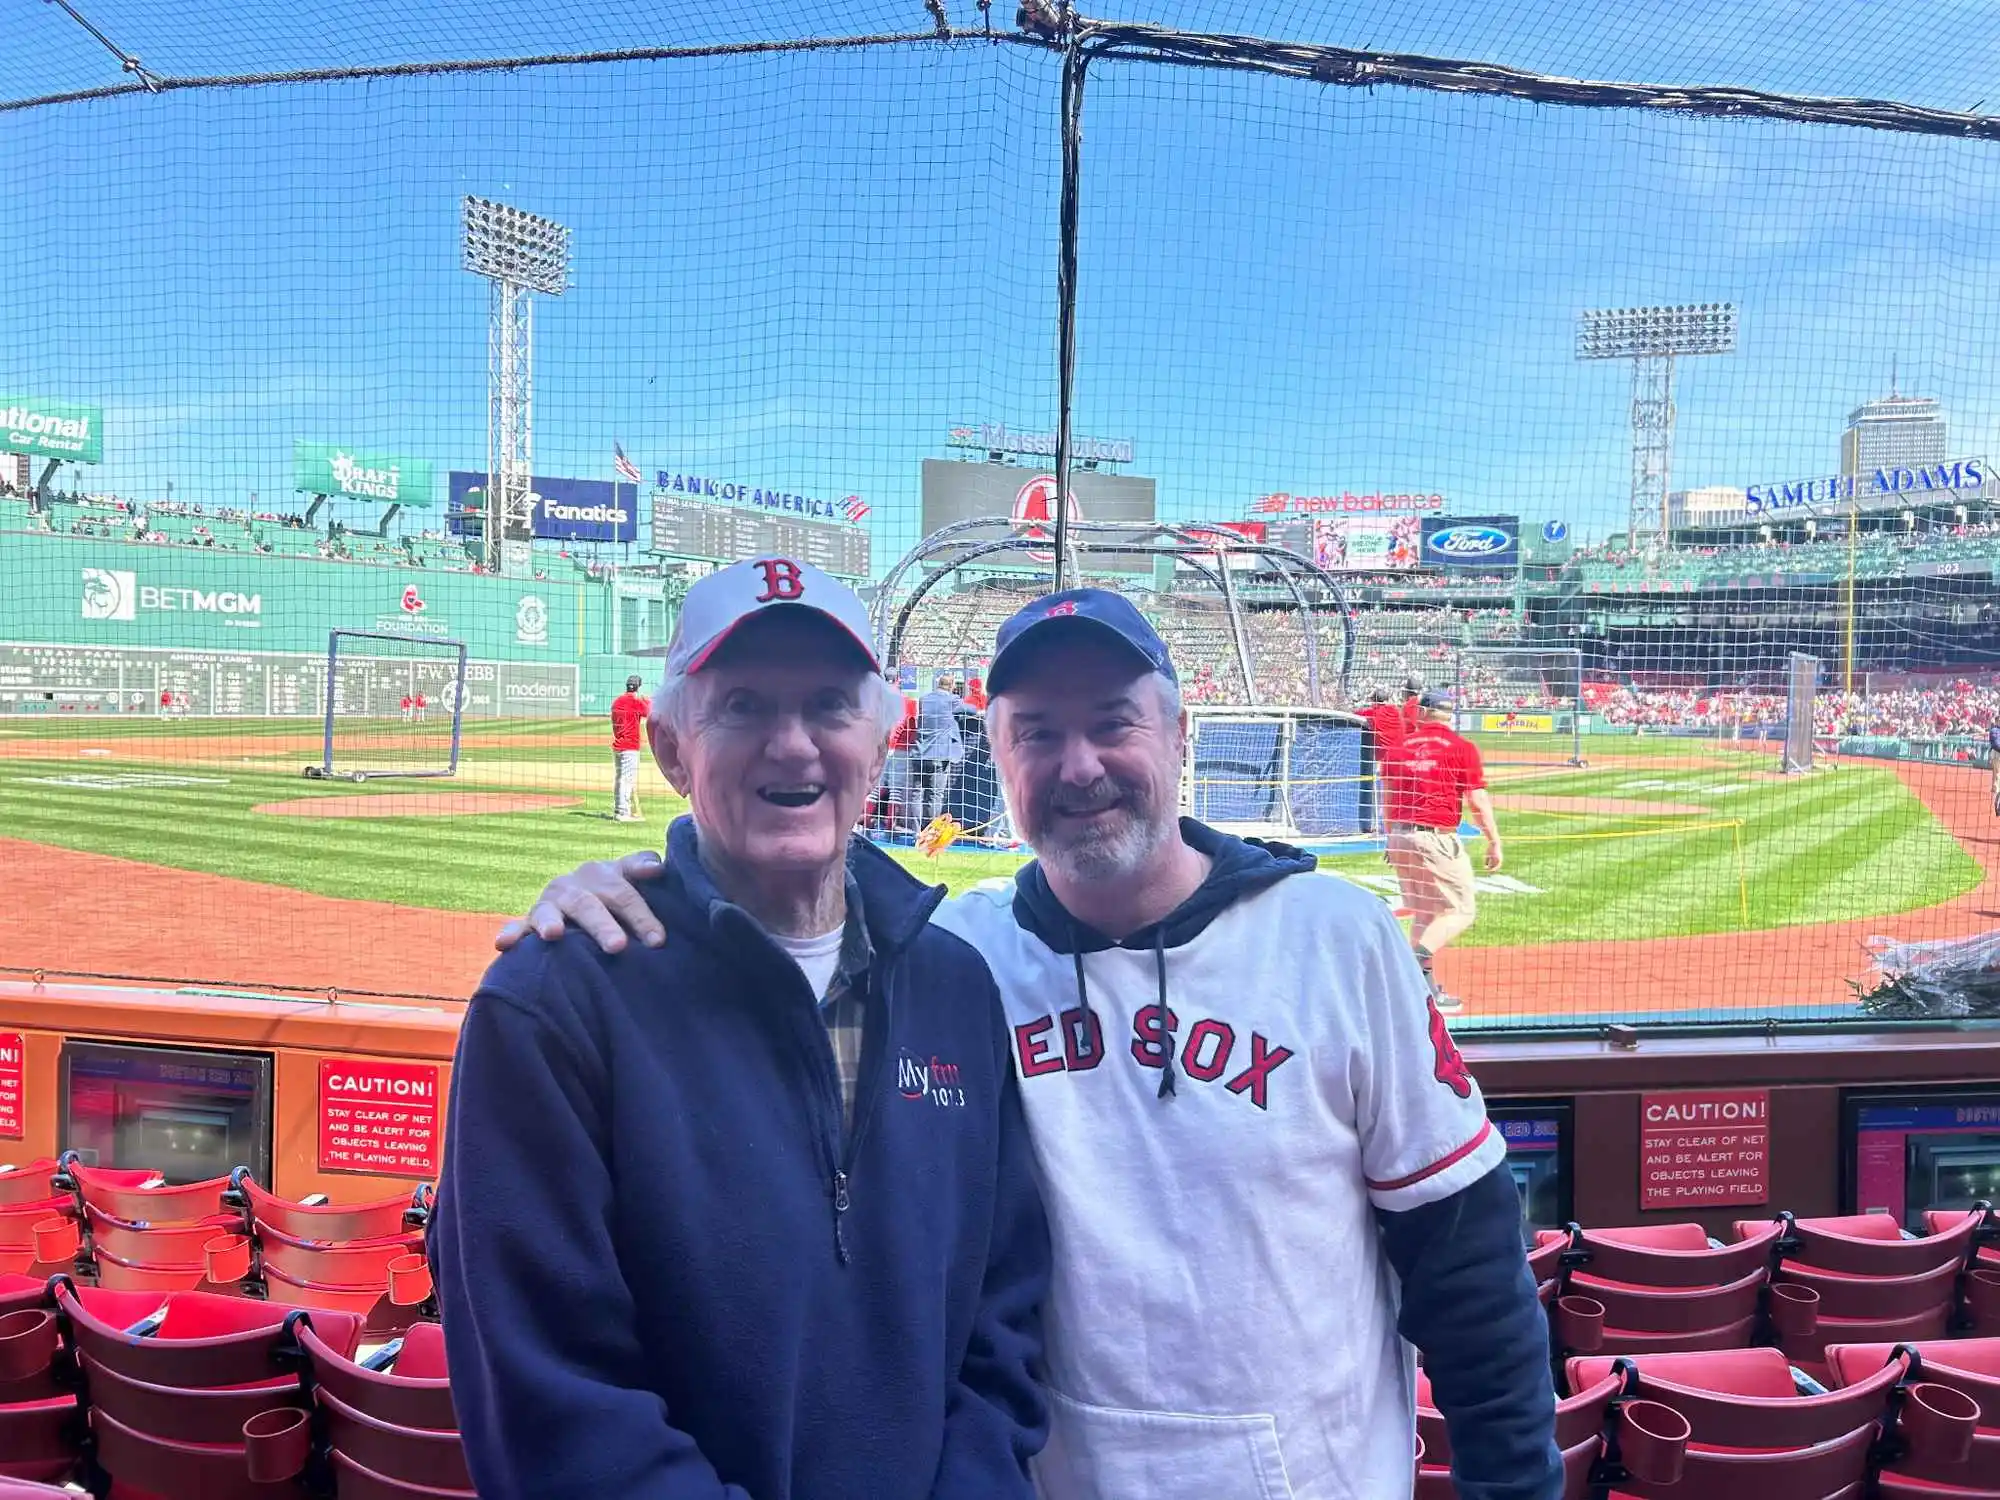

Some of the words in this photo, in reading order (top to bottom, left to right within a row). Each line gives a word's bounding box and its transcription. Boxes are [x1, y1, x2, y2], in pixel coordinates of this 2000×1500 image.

[37, 435, 84, 451] Rental
[334, 464, 399, 485] DRAFT
[1871, 459, 1983, 493] ADAMS
[341, 480, 398, 499] KINGS
[656, 470, 718, 496] BANK
[722, 483, 747, 502] OF
[754, 488, 834, 518] AMERICA
[1294, 494, 1339, 512] new
[1343, 490, 1442, 512] balance
[544, 500, 628, 522] Fanatics
[1443, 533, 1494, 551] Ford
[753, 559, 804, 603] B
[140, 586, 261, 614] BETMGM
[376, 620, 448, 634] FOUNDATION
[12, 648, 73, 656] FENWAY
[170, 654, 217, 662] AMERICAN
[505, 682, 570, 696] moderna
[1130, 1003, 1294, 1111] SOX
[899, 1057, 928, 1095] My
[328, 1075, 432, 1097] CAUTION!
[932, 1087, 966, 1107] 101.3
[328, 1108, 350, 1117] STAY
[355, 1110, 389, 1120] CLEAR
[393, 1113, 408, 1122] OF
[412, 1115, 432, 1124] NET
[1646, 1102, 1765, 1121] CAUTION!
[329, 1123, 349, 1132] AND
[354, 1125, 368, 1134] BE
[372, 1126, 405, 1136] ALERT
[409, 1129, 431, 1138] FOR
[332, 1137, 379, 1148] OBJECTS
[384, 1141, 427, 1152] LEAVING
[1645, 1138, 1672, 1148] STAY
[1677, 1137, 1716, 1147] CLEAR
[1722, 1136, 1738, 1145] OF
[1743, 1135, 1765, 1145] NET
[329, 1151, 349, 1160] THE
[354, 1152, 396, 1164] PLAYING
[401, 1156, 430, 1167] FIELD
[1647, 1155, 1670, 1165] AND
[1675, 1154, 1692, 1164] BE
[1697, 1152, 1734, 1162] ALERT
[1739, 1151, 1763, 1161] FOR
[1650, 1169, 1705, 1180] OBJECTS
[1711, 1167, 1759, 1178] LEAVING
[1647, 1187, 1670, 1197] THE
[1676, 1185, 1724, 1195] PLAYING
[1730, 1184, 1763, 1194] FIELD
